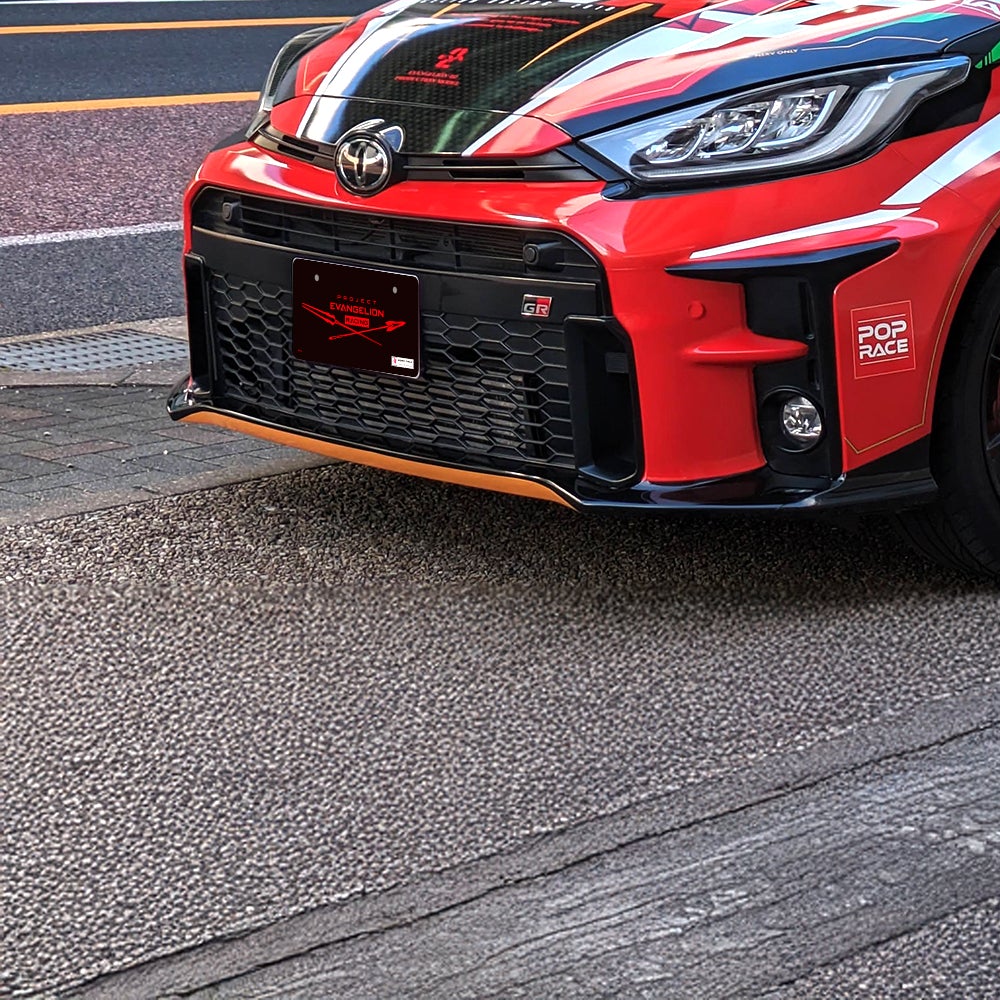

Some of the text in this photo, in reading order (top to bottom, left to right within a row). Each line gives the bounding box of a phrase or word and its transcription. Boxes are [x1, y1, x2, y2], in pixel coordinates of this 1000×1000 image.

[337, 294, 377, 305] PROJECT
[329, 302, 385, 318] EVANGELION
[523, 303, 549, 315] GR
[858, 320, 907, 344] POP
[859, 338, 909, 360] RACE
